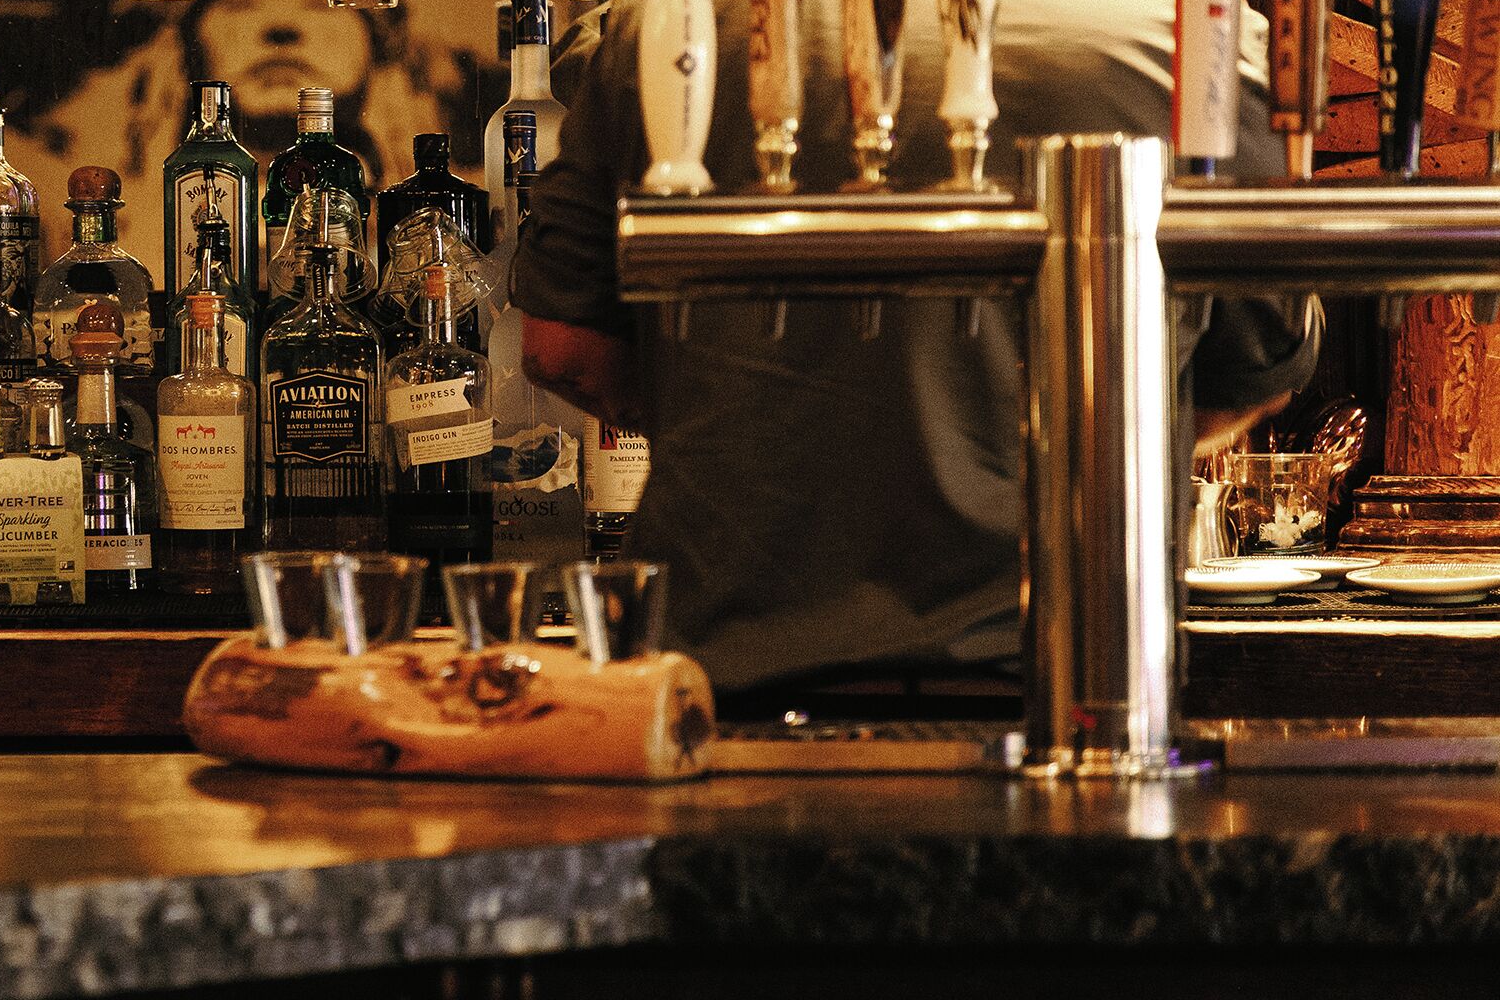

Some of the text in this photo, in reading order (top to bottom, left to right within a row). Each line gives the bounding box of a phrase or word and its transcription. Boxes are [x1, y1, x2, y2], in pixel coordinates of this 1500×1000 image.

[186, 183, 228, 201] BOMAY
[279, 386, 361, 404] AVIATION
[409, 388, 456, 402] EMPRESS
[411, 401, 435, 411] 1908
[290, 409, 350, 419] AMERICAN GIN
[412, 431, 457, 443] INDIGO GIN
[162, 446, 179, 454] DOS
[499, 501, 560, 516] GOOSE
